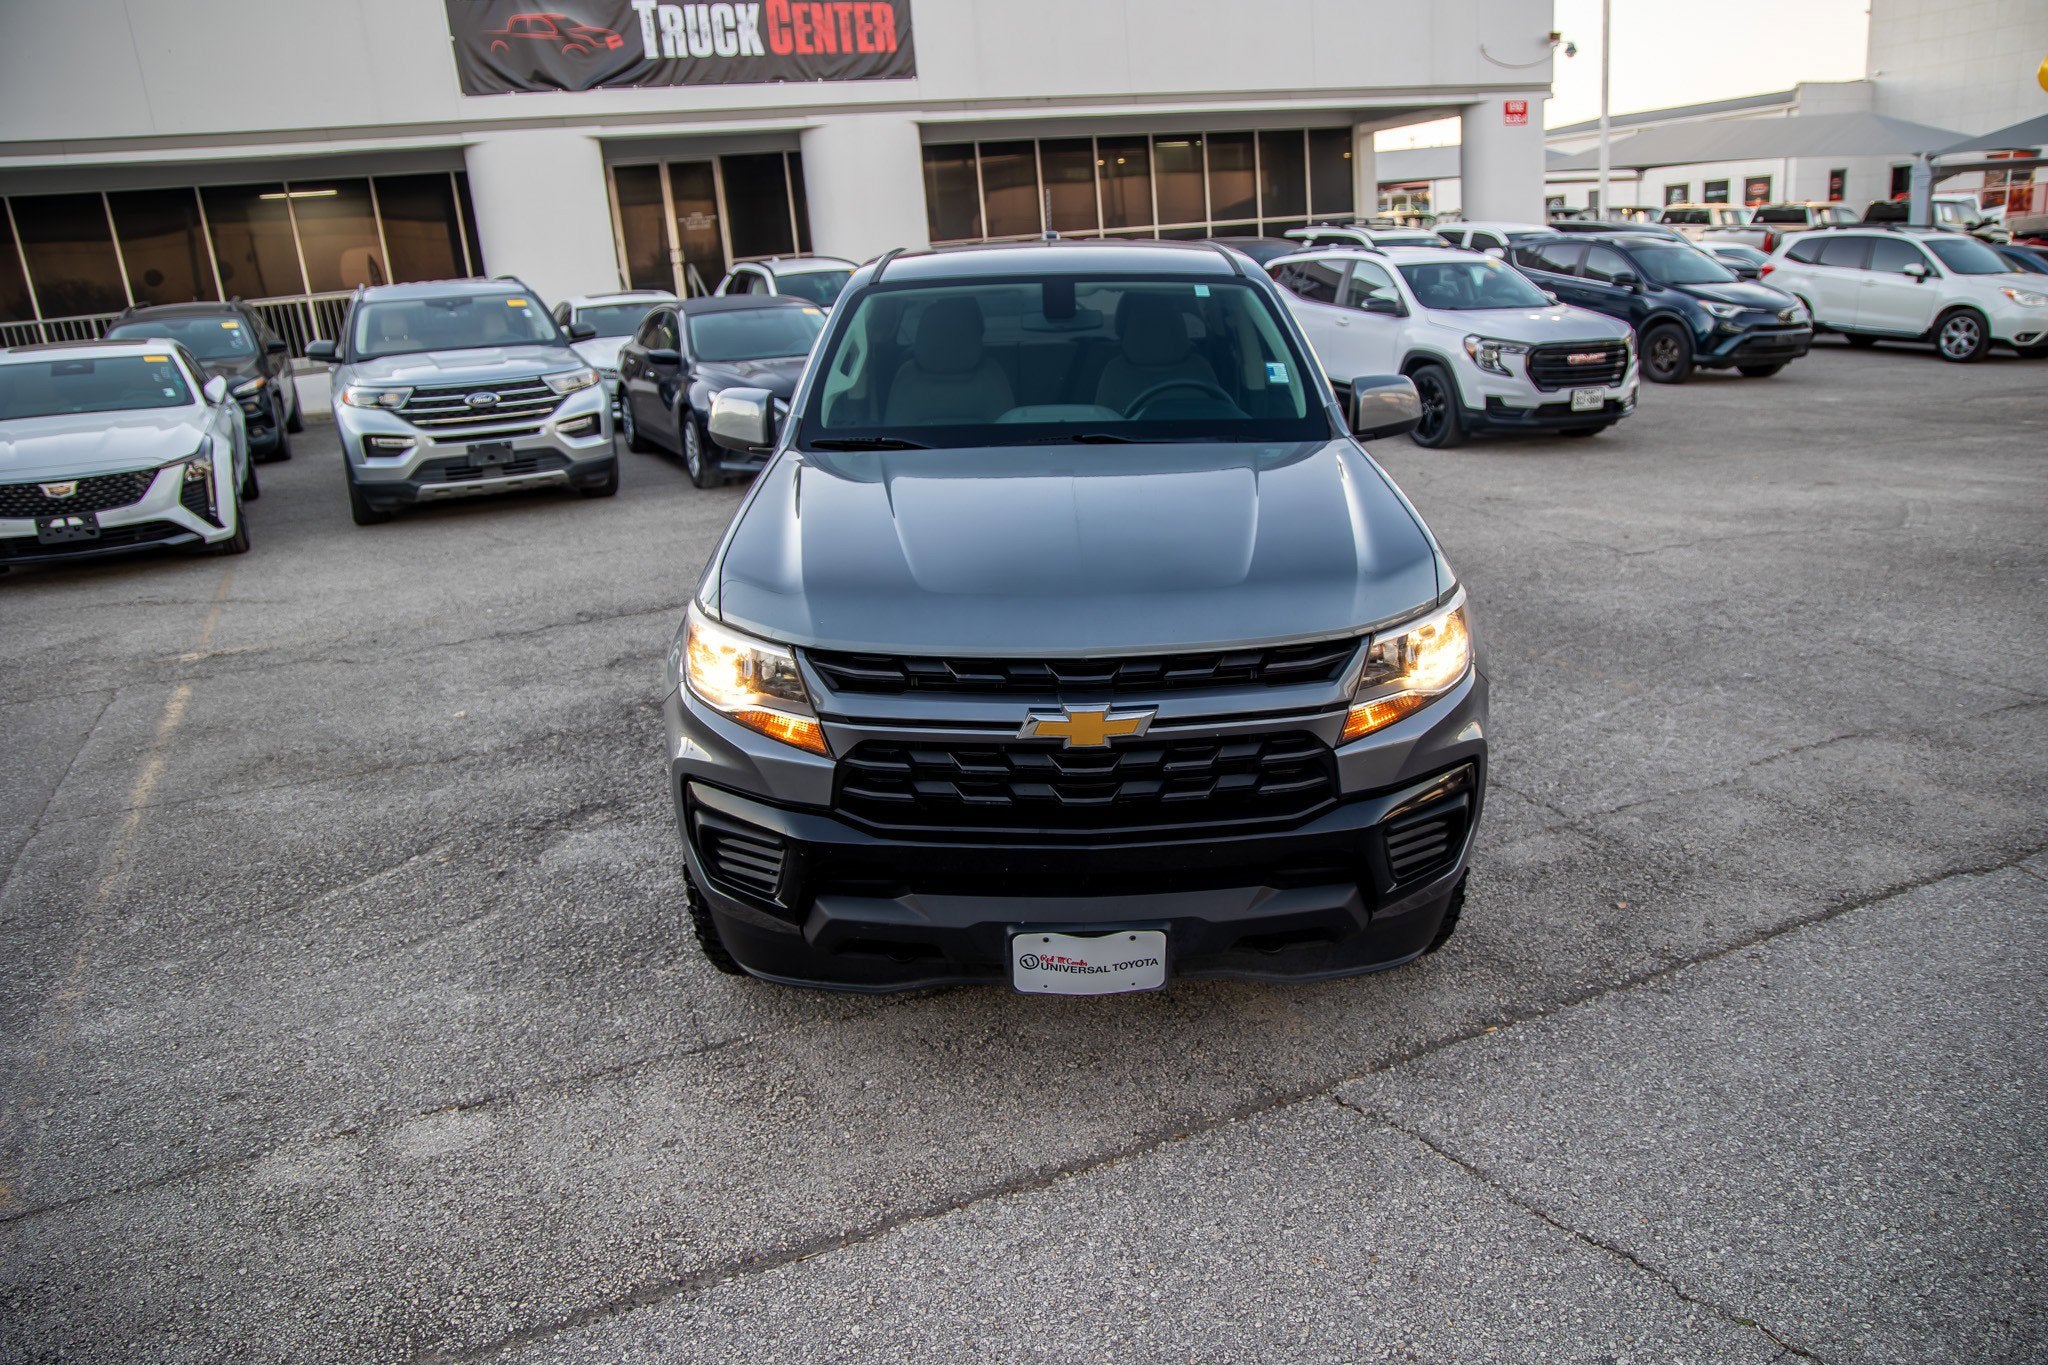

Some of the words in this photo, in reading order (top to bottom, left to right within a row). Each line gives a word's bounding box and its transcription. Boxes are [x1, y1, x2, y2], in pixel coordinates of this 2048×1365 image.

[631, 0, 764, 58] TRUCK
[768, 0, 897, 54] CENTER
[1041, 962, 1111, 974] UNIVERSAL
[1112, 958, 1159, 972] TOYOTA
